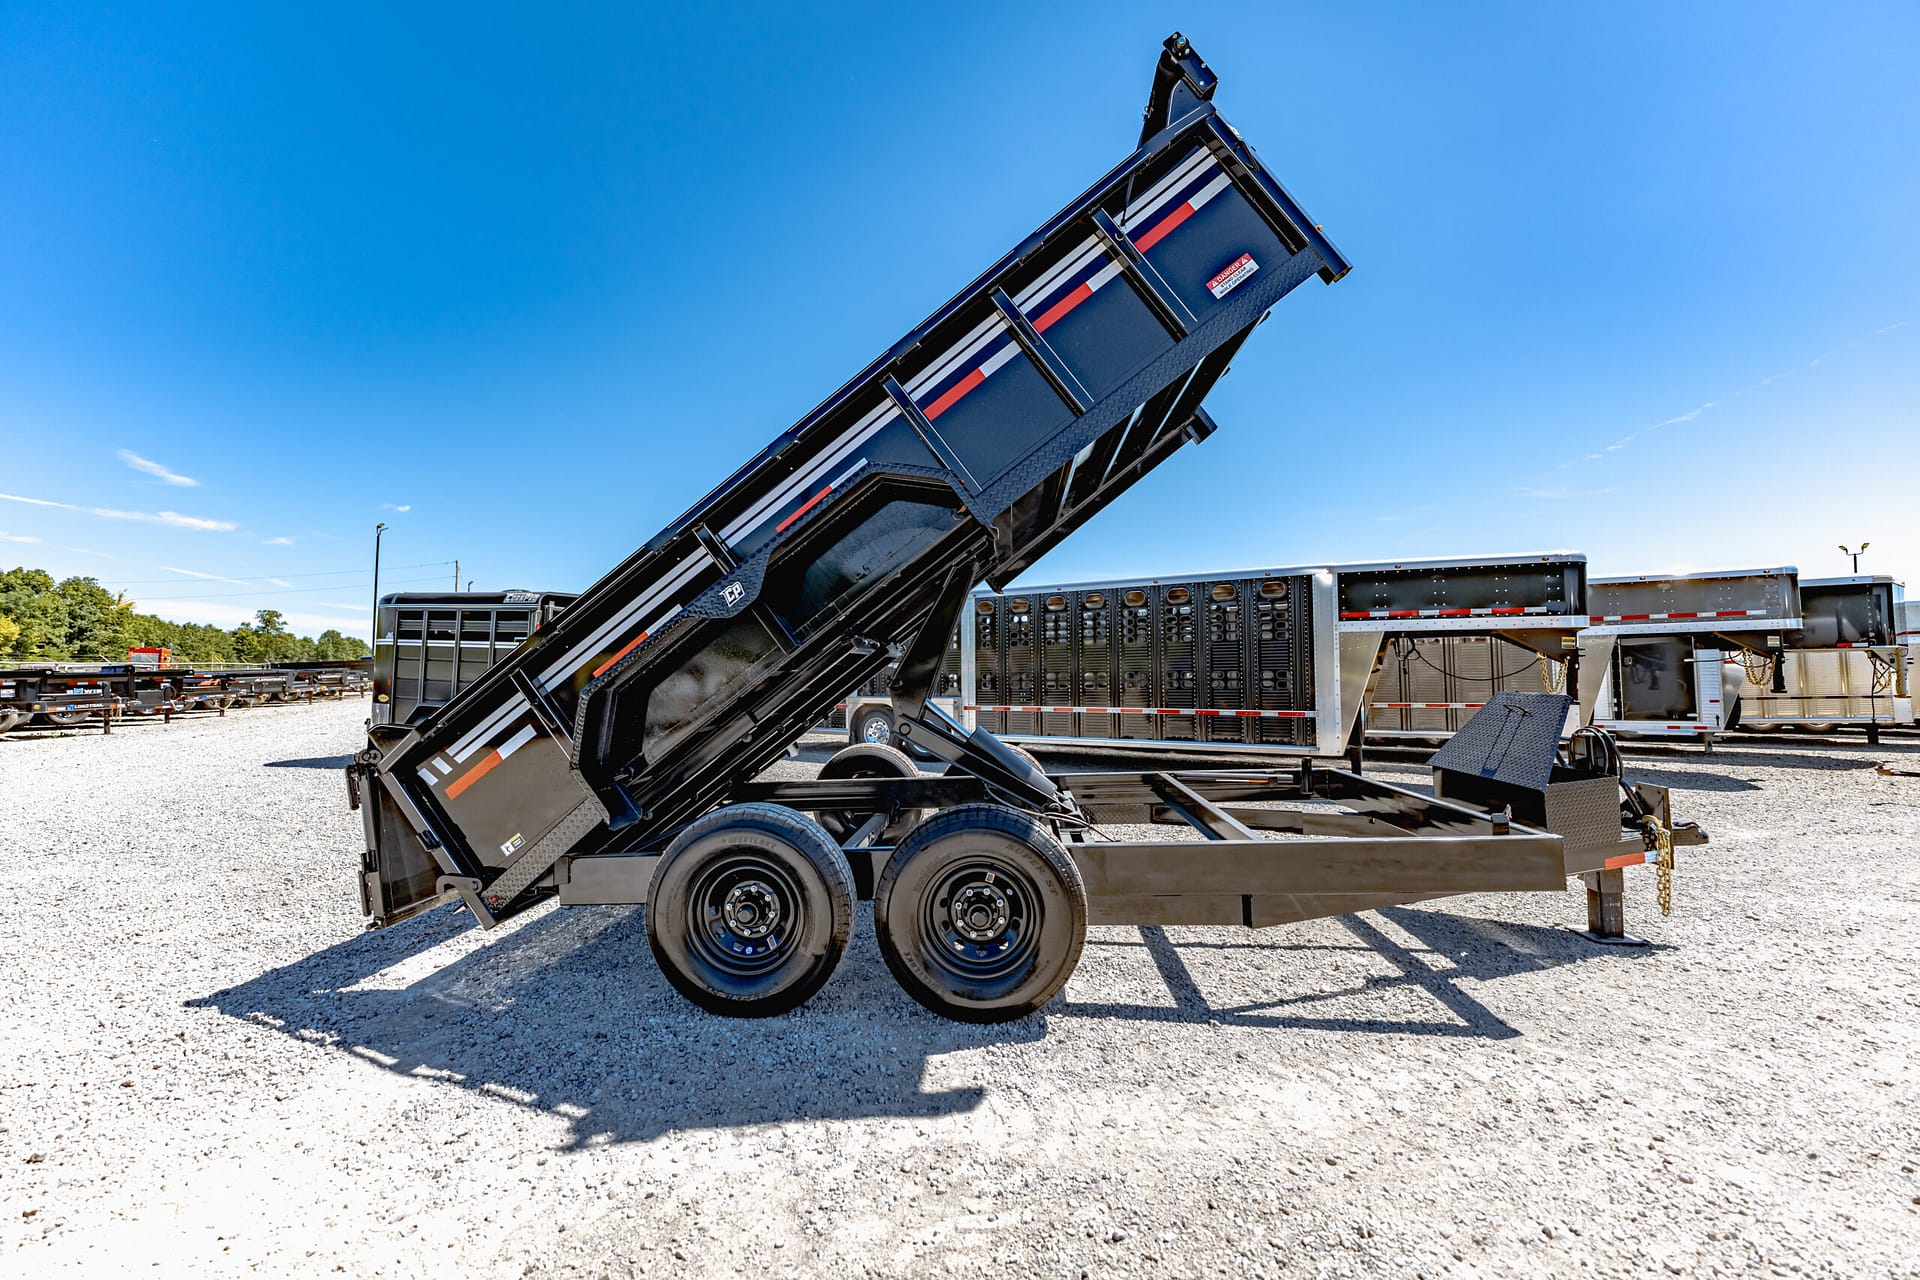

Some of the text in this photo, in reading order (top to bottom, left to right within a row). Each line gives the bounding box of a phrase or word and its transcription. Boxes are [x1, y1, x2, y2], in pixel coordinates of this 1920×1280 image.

[1217, 262, 1241, 282] DANGER
[1220, 266, 1247, 288] STAND CLEAR
[1045, 879, 1059, 897] ST
